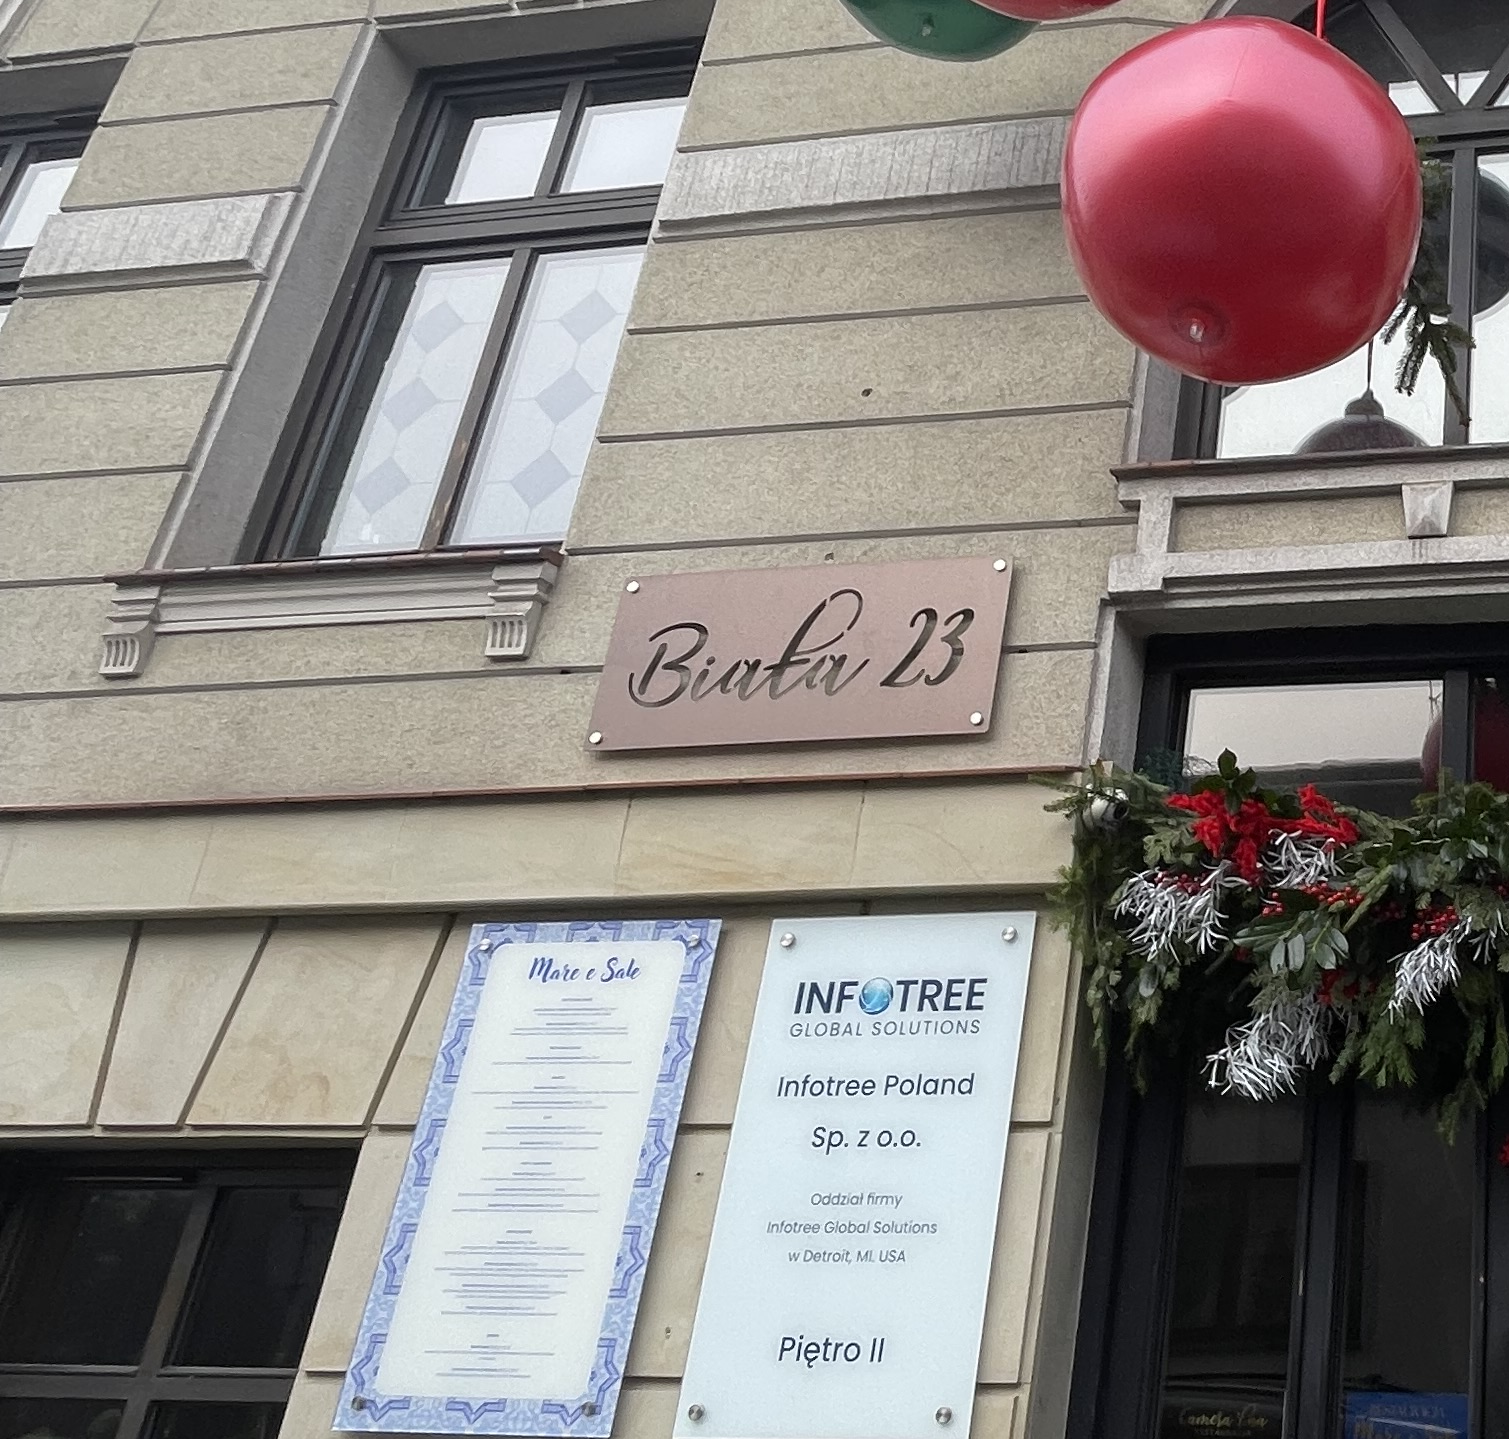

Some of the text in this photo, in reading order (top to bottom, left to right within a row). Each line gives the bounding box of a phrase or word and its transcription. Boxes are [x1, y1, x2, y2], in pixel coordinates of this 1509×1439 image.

[627, 588, 976, 708] Biała 23
[528, 957, 641, 983] Mare e Sale
[794, 977, 988, 1015] INFOTREE
[790, 1019, 981, 1037] GLOBAL SOLUTIONS
[777, 1073, 975, 1097] Infotree Poland
[811, 1126, 921, 1155] Sp. z o.o.
[811, 1193, 903, 1209] Oddział firmy
[766, 1220, 938, 1234] Infotree Global Solutions
[788, 1251, 801, 1262] w
[803, 1249, 851, 1265] Detroit,
[879, 1250, 906, 1262] USA
[778, 1335, 861, 1368] Piętro
